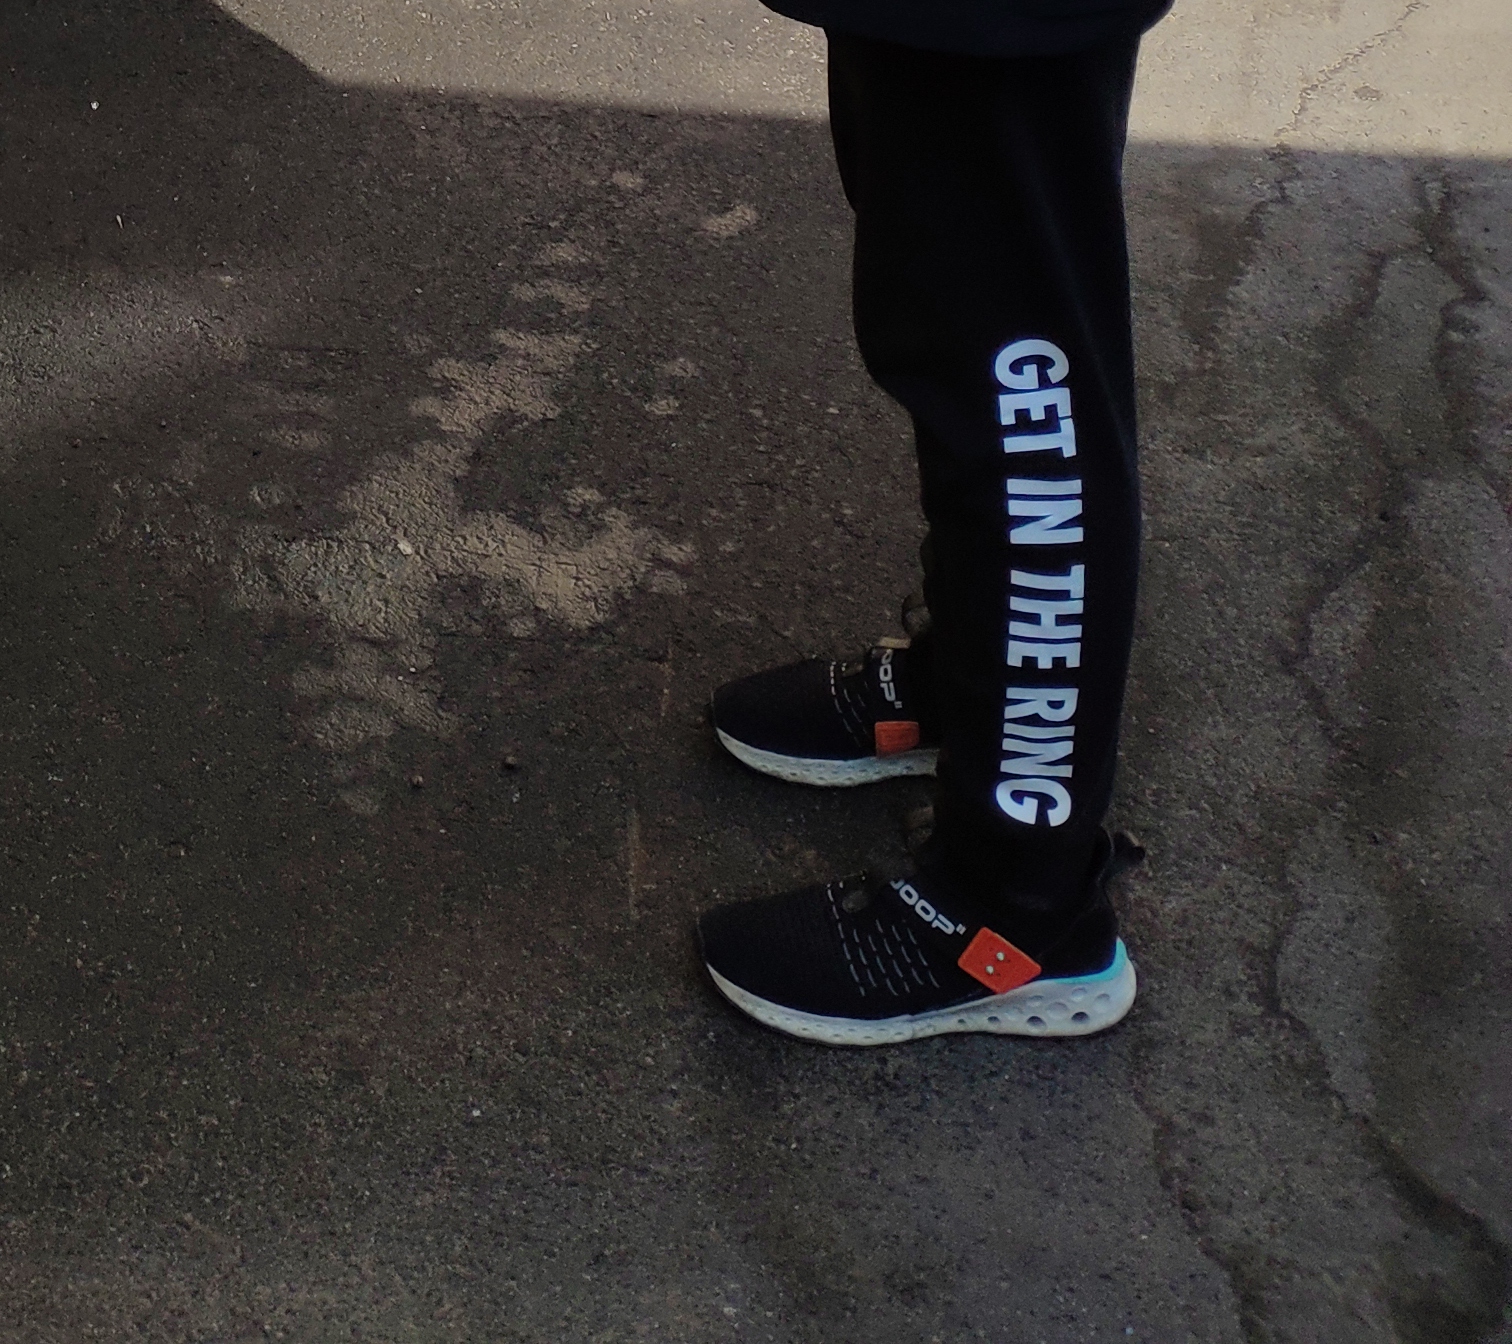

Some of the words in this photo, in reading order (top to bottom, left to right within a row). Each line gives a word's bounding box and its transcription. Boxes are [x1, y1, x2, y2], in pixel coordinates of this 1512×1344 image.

[994, 338, 1078, 460] GET
[1006, 477, 1085, 547] IN
[1004, 563, 1086, 671] THE
[995, 685, 1081, 829] RING
